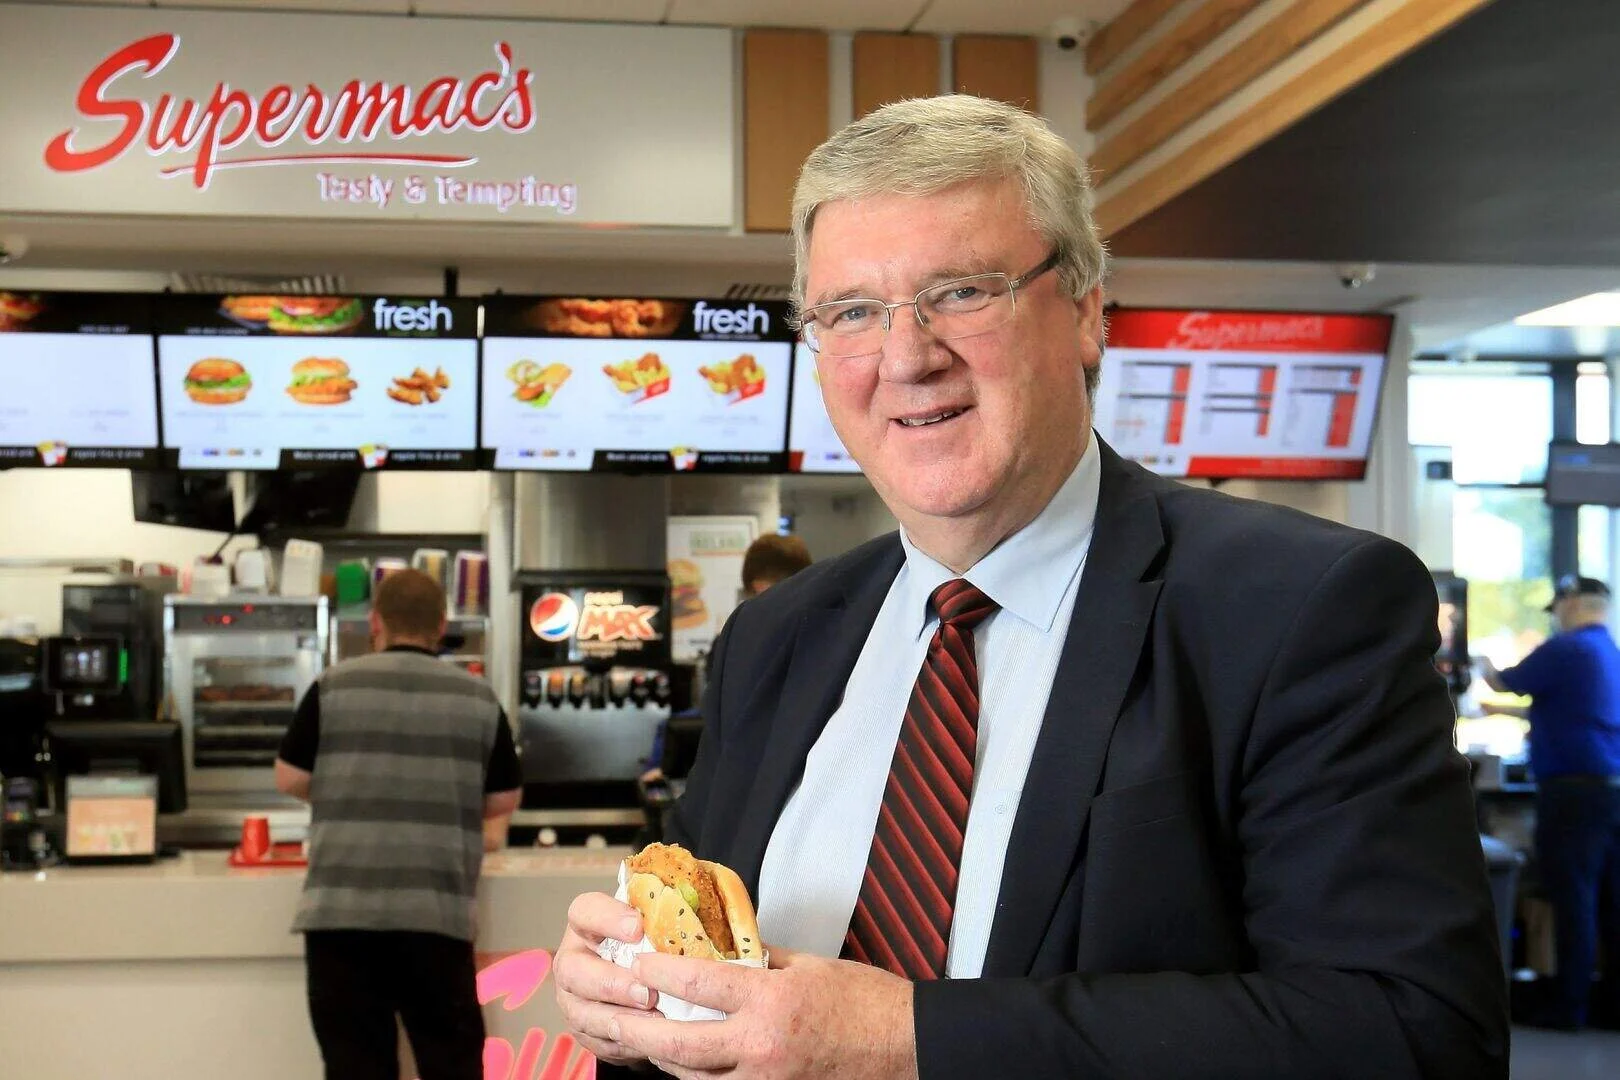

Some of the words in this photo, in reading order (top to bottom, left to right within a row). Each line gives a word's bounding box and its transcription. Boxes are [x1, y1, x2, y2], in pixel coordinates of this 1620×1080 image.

[43, 33, 536, 192] Supermac's
[317, 172, 394, 209] Tasty
[404, 174, 427, 204] &
[435, 175, 577, 215] Tempting
[373, 298, 453, 332] fresh
[692, 302, 770, 335] fresh
